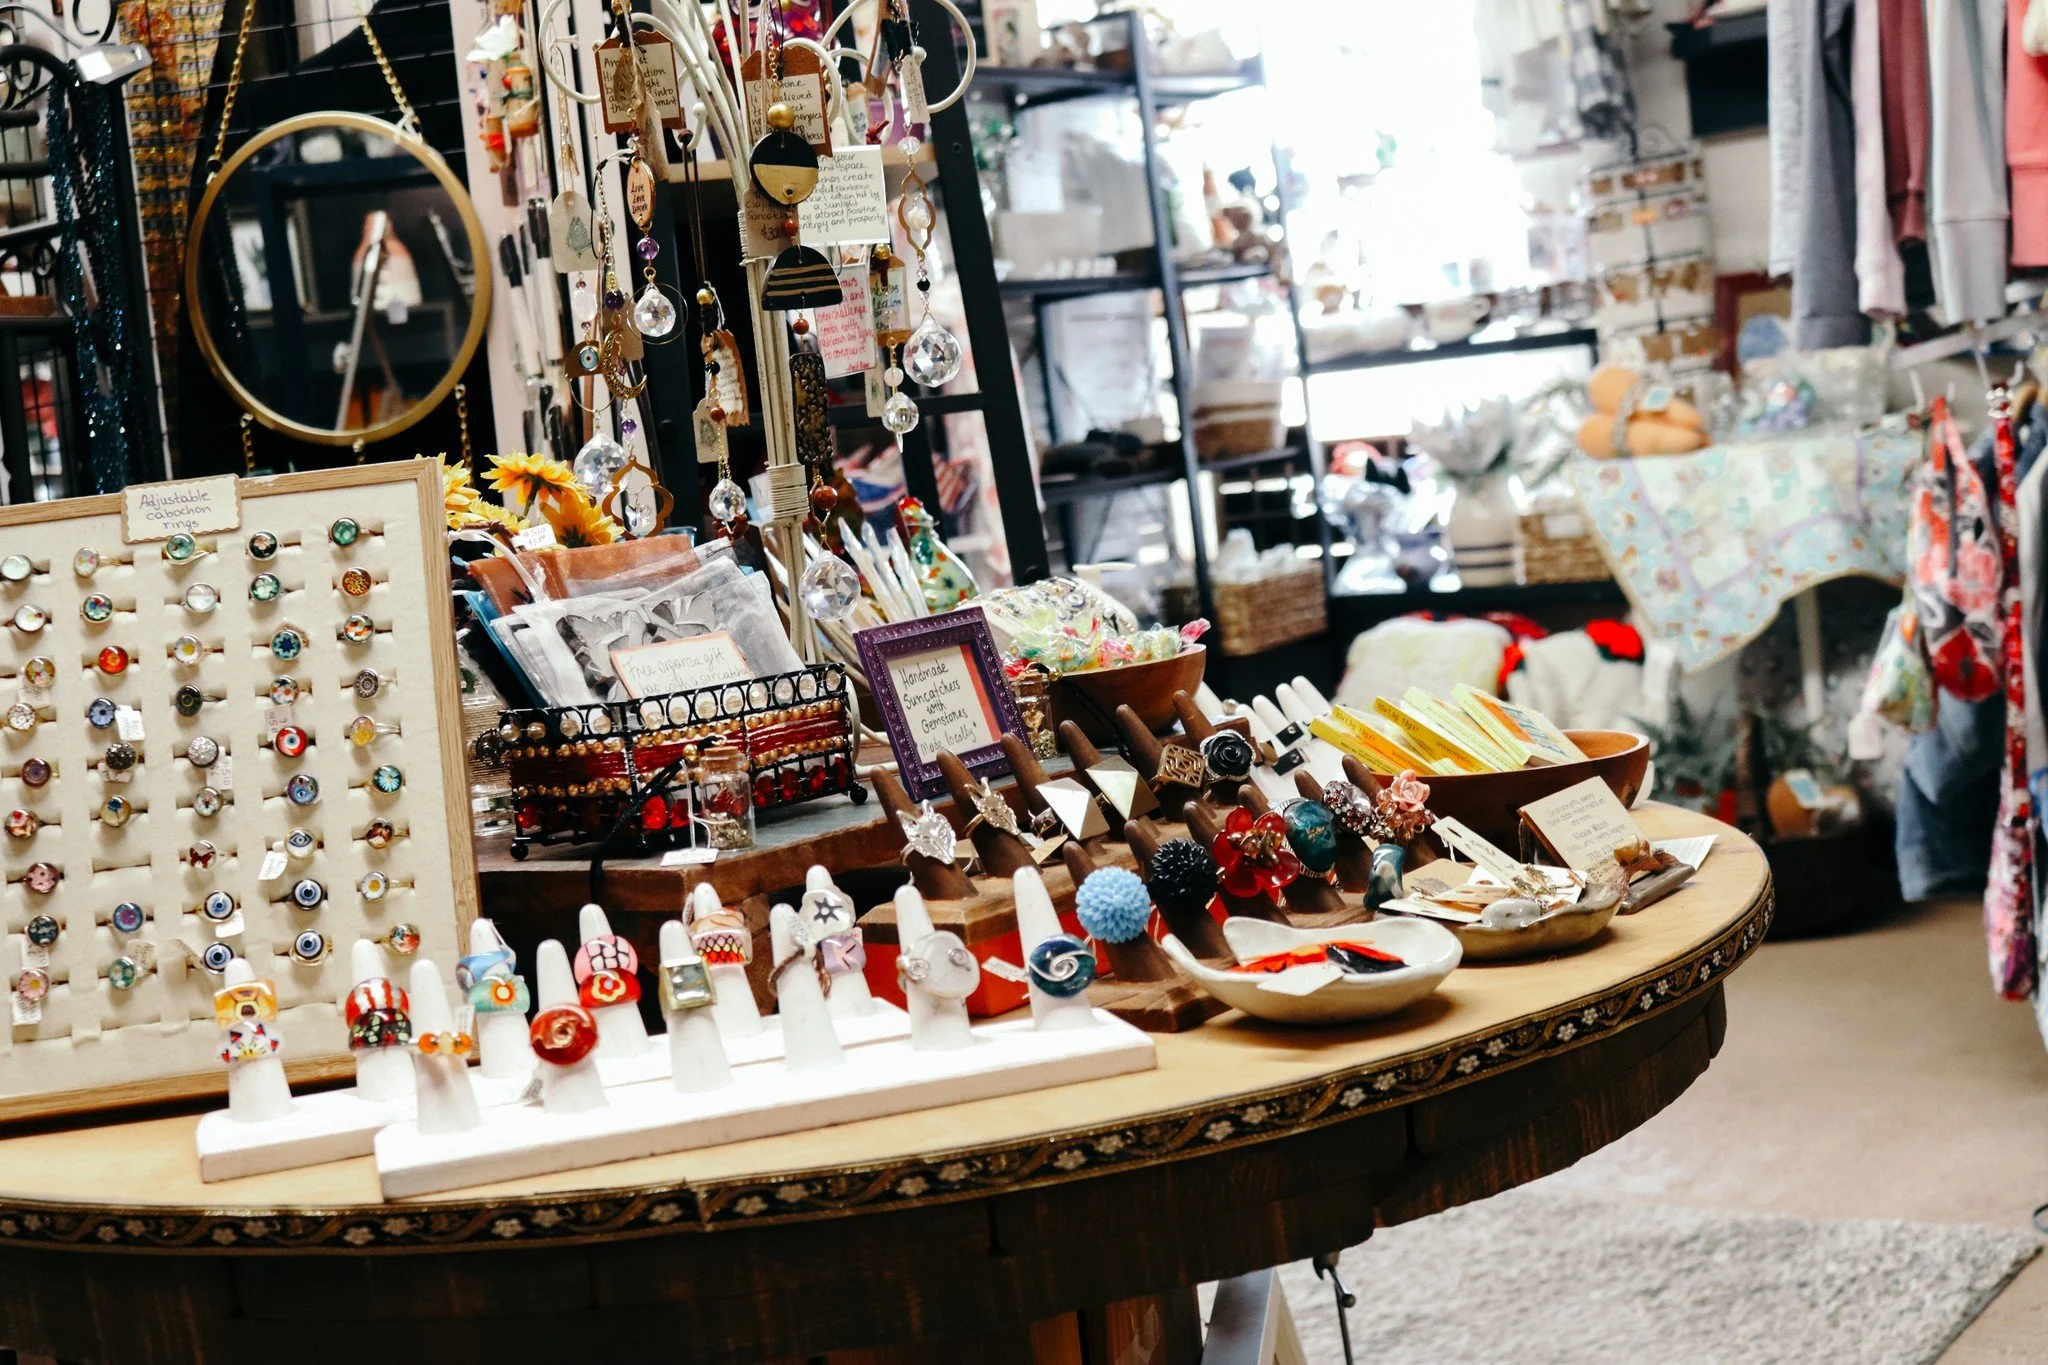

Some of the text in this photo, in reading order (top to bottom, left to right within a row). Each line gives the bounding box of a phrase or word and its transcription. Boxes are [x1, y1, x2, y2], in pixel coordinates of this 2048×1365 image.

[793, 112, 823, 126] nergies
[842, 171, 874, 181] create
[815, 208, 844, 219] attract
[846, 205, 878, 217] positive
[139, 489, 212, 510] Adjustable
[146, 506, 212, 521] cabochon
[163, 519, 200, 533] rings
[622, 655, 656, 680] Free
[703, 647, 726, 672] gift
[898, 658, 949, 691] Handmade
[903, 679, 961, 710] Suncatchers
[926, 699, 947, 715] with
[921, 708, 968, 734] Gemstones
